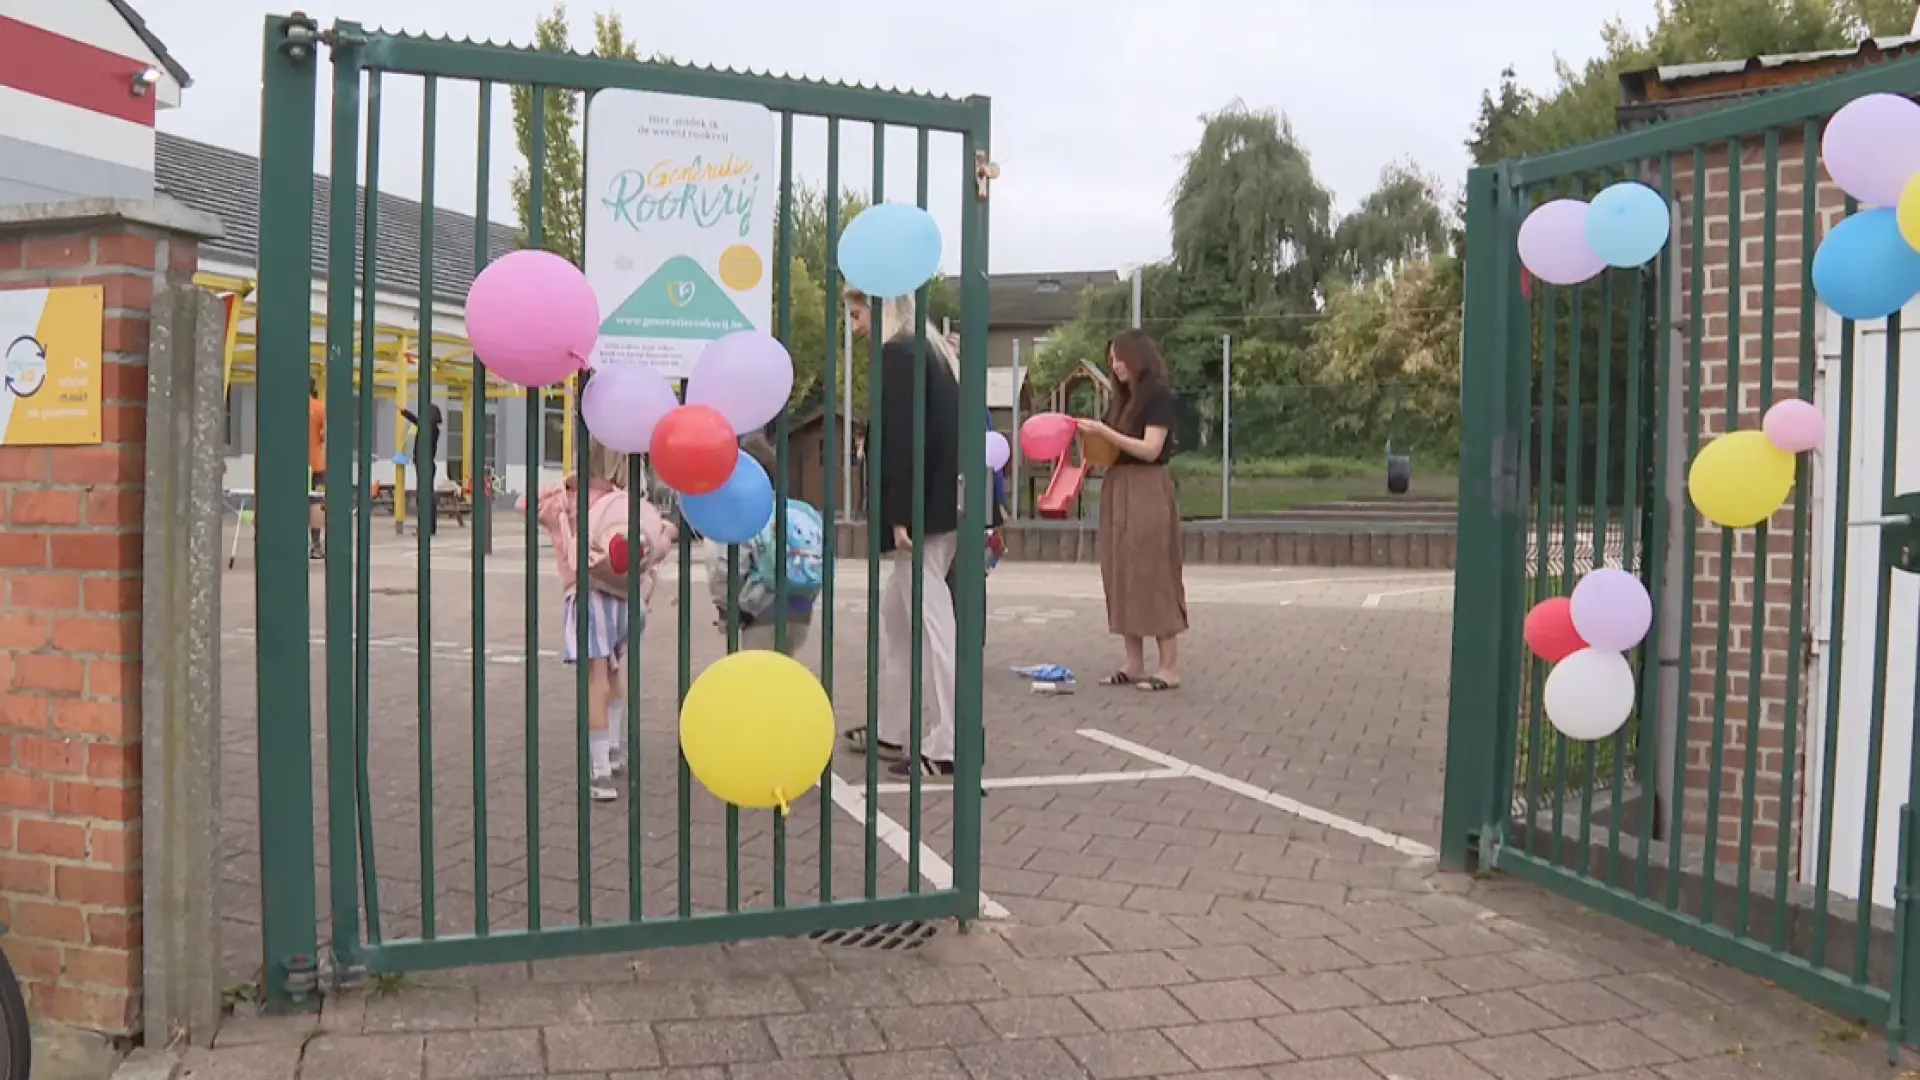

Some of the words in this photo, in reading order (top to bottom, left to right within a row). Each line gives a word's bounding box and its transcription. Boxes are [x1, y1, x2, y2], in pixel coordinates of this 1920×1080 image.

[637, 123, 650, 135] de
[652, 127, 686, 138] wereld
[688, 129, 729, 144] rookvrij
